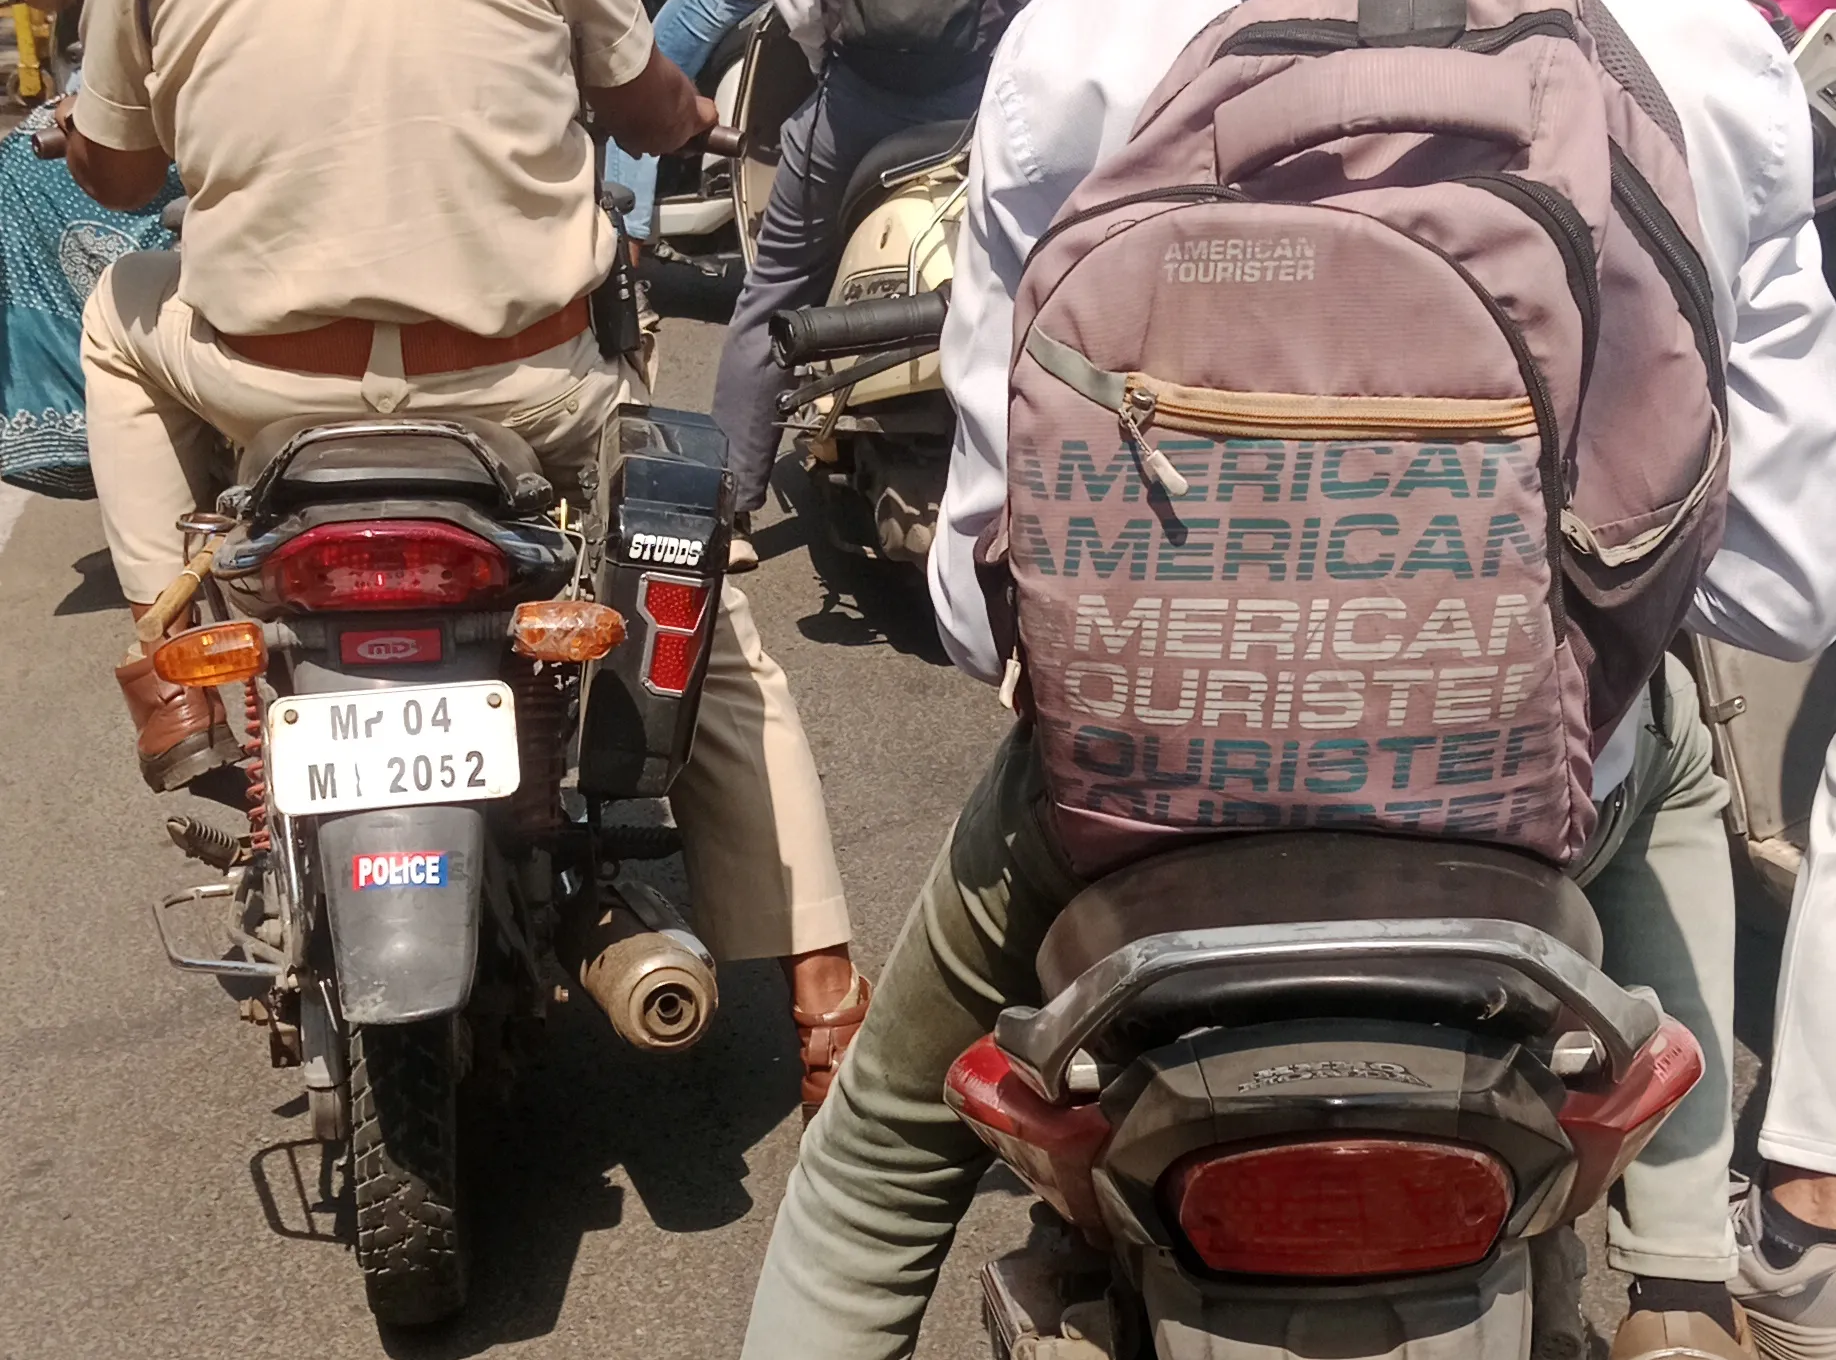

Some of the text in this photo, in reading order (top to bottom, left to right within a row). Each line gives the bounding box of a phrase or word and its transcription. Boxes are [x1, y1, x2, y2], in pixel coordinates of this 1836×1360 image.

[1164, 237, 1316, 261] AMERICAN
[1163, 259, 1315, 283] TOURISTER
[629, 533, 703, 566] STUDDS
[403, 696, 451, 736] 04
[308, 750, 486, 801] M 2052
[358, 854, 441, 887] POLICE
